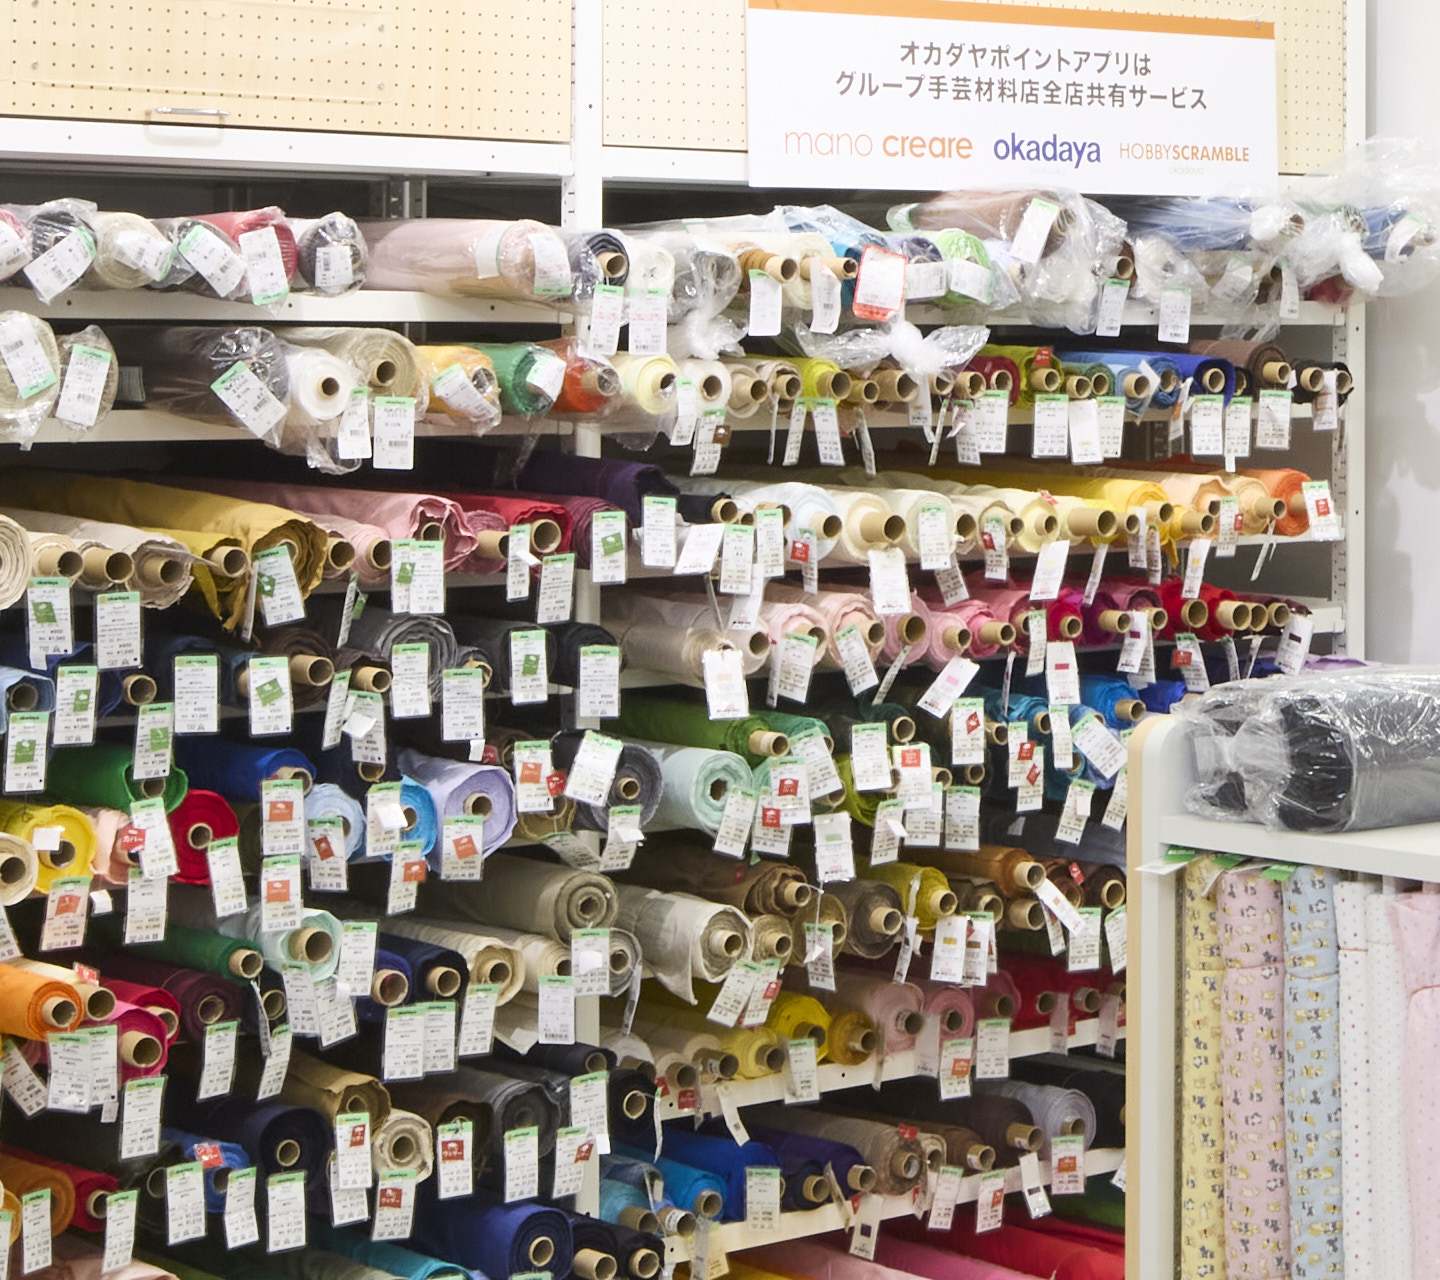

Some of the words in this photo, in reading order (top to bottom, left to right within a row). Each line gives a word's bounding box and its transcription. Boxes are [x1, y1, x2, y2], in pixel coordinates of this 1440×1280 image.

[900, 41, 1151, 76] オカダヤポイントアプリは
[836, 70, 1207, 110] グループ手芸材料店全店共有サービス
[785, 131, 873, 157] mano
[882, 134, 973, 159] creare
[993, 132, 1102, 169] okadaya
[1119, 142, 1250, 162] HOBBYSCRAMBLE
